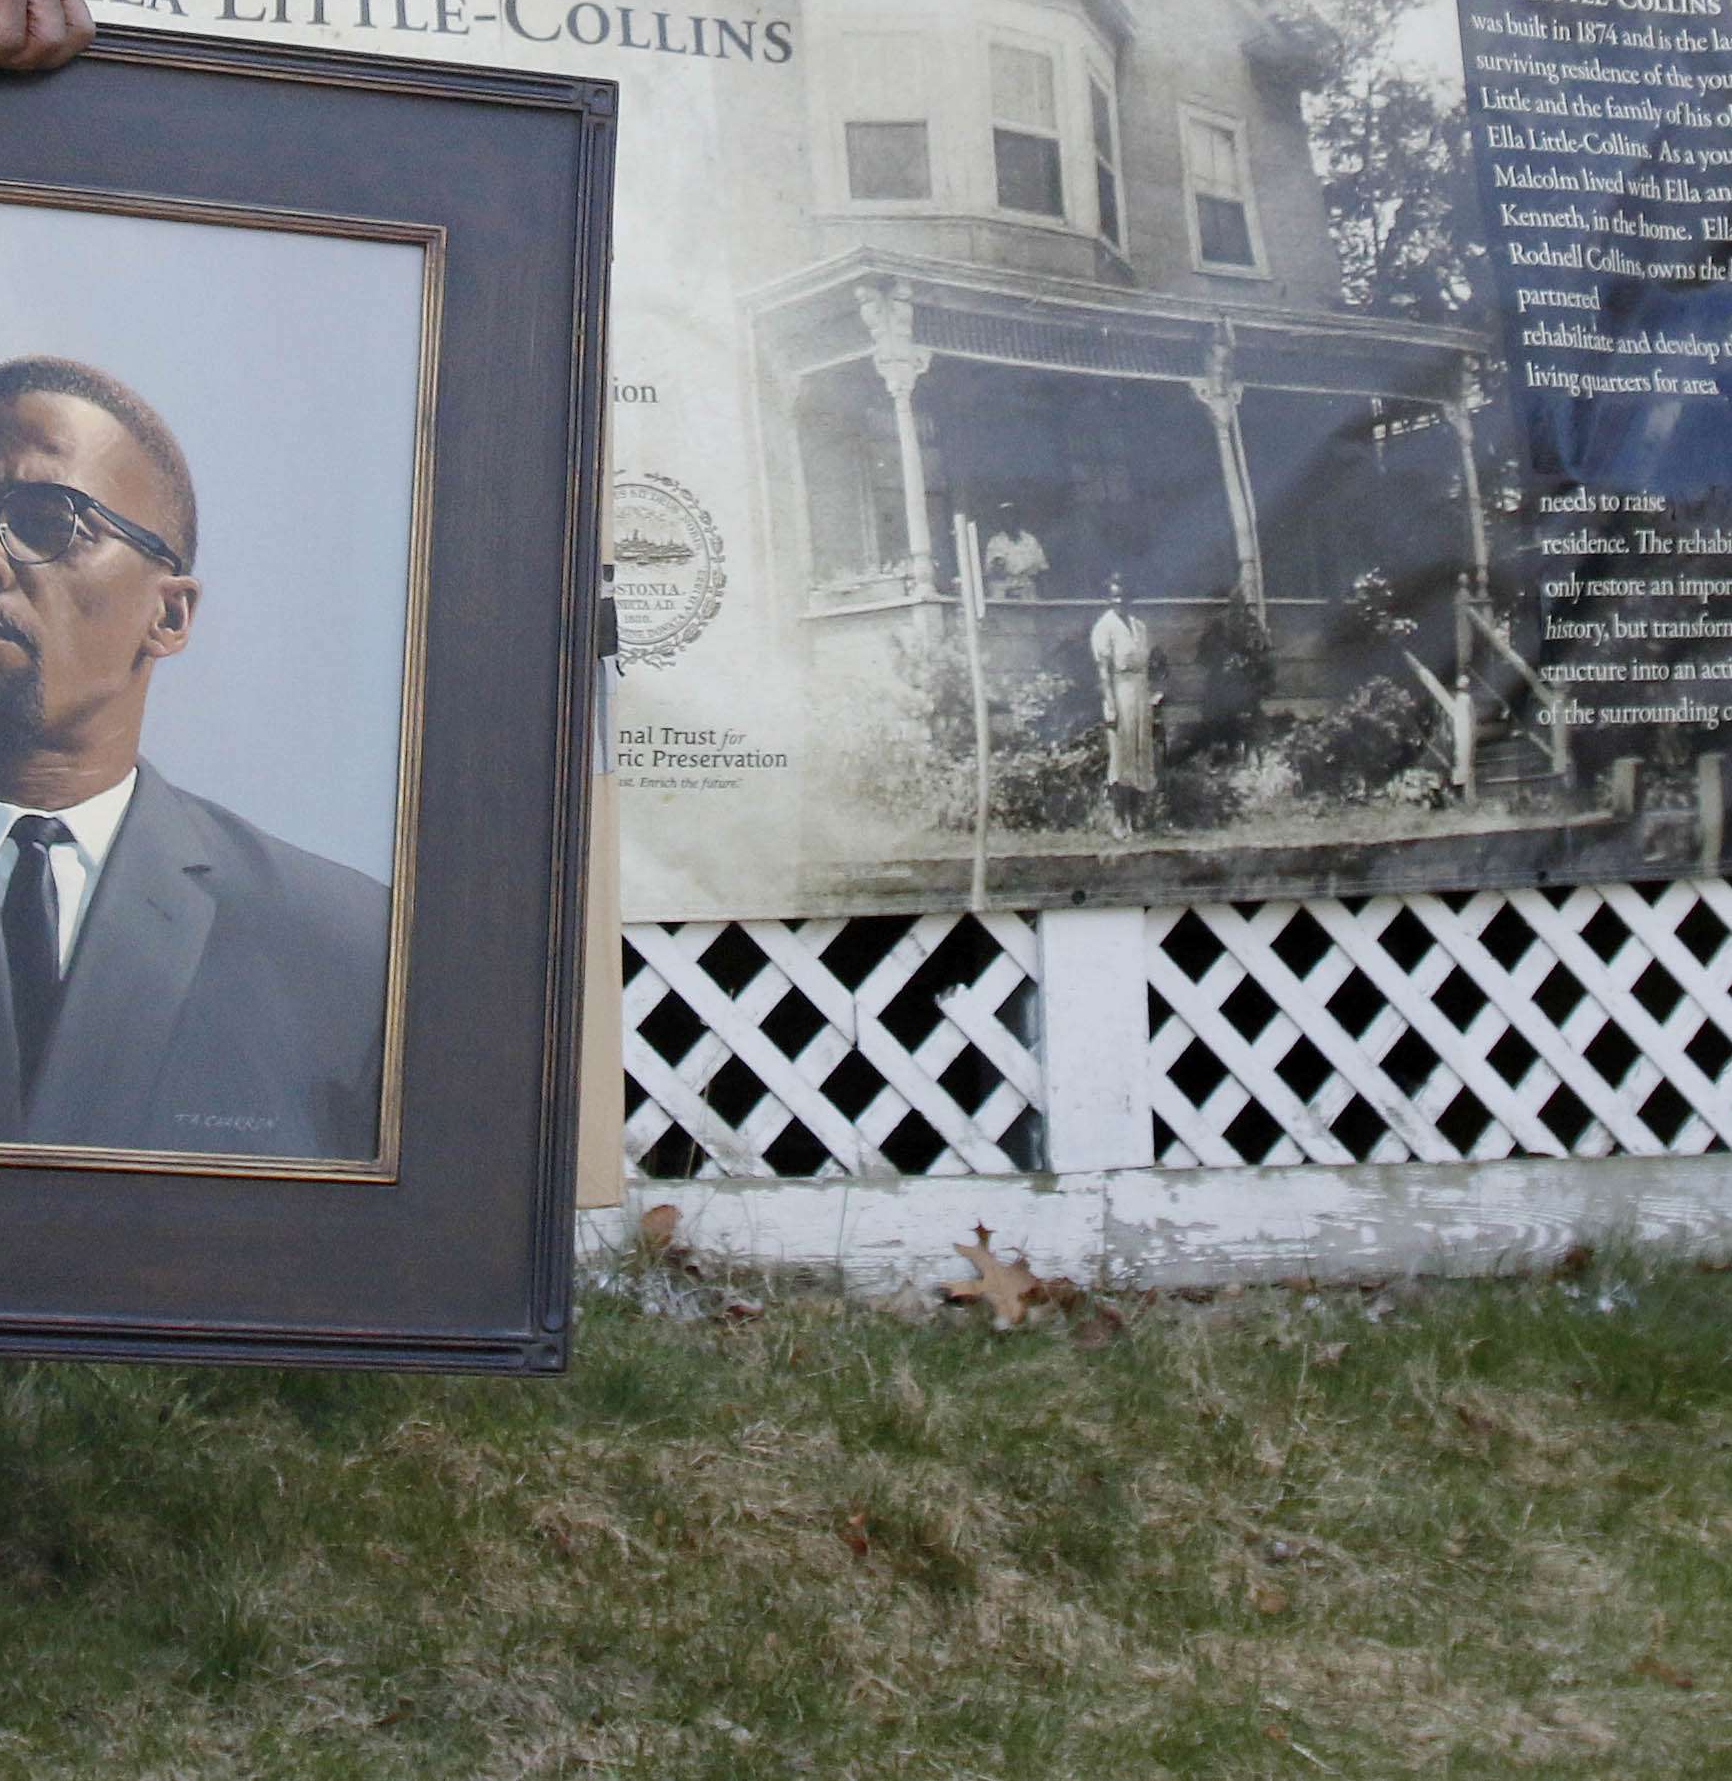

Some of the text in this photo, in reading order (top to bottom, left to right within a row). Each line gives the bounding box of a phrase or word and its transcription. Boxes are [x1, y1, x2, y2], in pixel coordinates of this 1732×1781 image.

[1471, 13, 1504, 33] was
[1507, 14, 1548, 40] built
[1553, 18, 1572, 41] in
[1576, 21, 1617, 46] 1874
[1622, 26, 1656, 48] and
[1657, 30, 1671, 50] is
[1674, 28, 1708, 52] the
[1476, 53, 1560, 84] surviving
[1561, 57, 1642, 84] residence
[1643, 61, 1666, 86] of
[1667, 65, 1693, 89] the
[1481, 86, 1531, 112] Little
[1536, 93, 1567, 115] and
[1572, 95, 1602, 119] the
[1604, 96, 1663, 128] family
[1666, 102, 1687, 123] of
[1685, 102, 1713, 127] his
[1487, 123, 1526, 150] Ella
[1529, 126, 1653, 161] Little-Collins.
[1658, 138, 1680, 164] As
[1683, 150, 1695, 165] a
[1493, 164, 1579, 192] Malcolm
[1581, 168, 1624, 195] lived
[1628, 174, 1661, 199] with
[1665, 179, 1702, 204] Ella
[1500, 203, 1590, 231] Kenneth,
[1593, 208, 1610, 233] in
[1613, 211, 1638, 236] the
[1638, 216, 1693, 242] home.
[1508, 242, 1582, 267] Rodnell
[1587, 245, 1645, 279] Collins,
[1647, 263, 1696, 280] owns
[1700, 259, 1726, 281] the
[1517, 284, 1601, 313] partnered
[1523, 323, 1614, 353] rehabilitate
[1617, 331, 1651, 354] and
[1655, 331, 1719, 362] develop
[614, 376, 660, 405] ion
[1526, 361, 1719, 399] living quarters for area
[1539, 486, 1597, 513] needs
[1601, 495, 1621, 512] to
[1623, 492, 1667, 512] raise
[1541, 528, 1630, 555] residence.
[1635, 528, 1674, 554] The
[1546, 573, 1586, 605] only
[1586, 577, 1645, 597] restore
[1650, 578, 1674, 596] an
[1545, 614, 1611, 646] history,
[1614, 613, 1648, 639] but
[1540, 657, 1628, 683] structure
[1631, 657, 1669, 681] into
[1674, 663, 1697, 680] an
[1537, 698, 1565, 724] of
[1565, 701, 1596, 724] the
[1600, 697, 1719, 730] surrounding
[620, 727, 747, 751] nal Trust for
[618, 749, 787, 768] ric Preservation
[640, 777, 677, 788] Enrich
[681, 777, 699, 789] the
